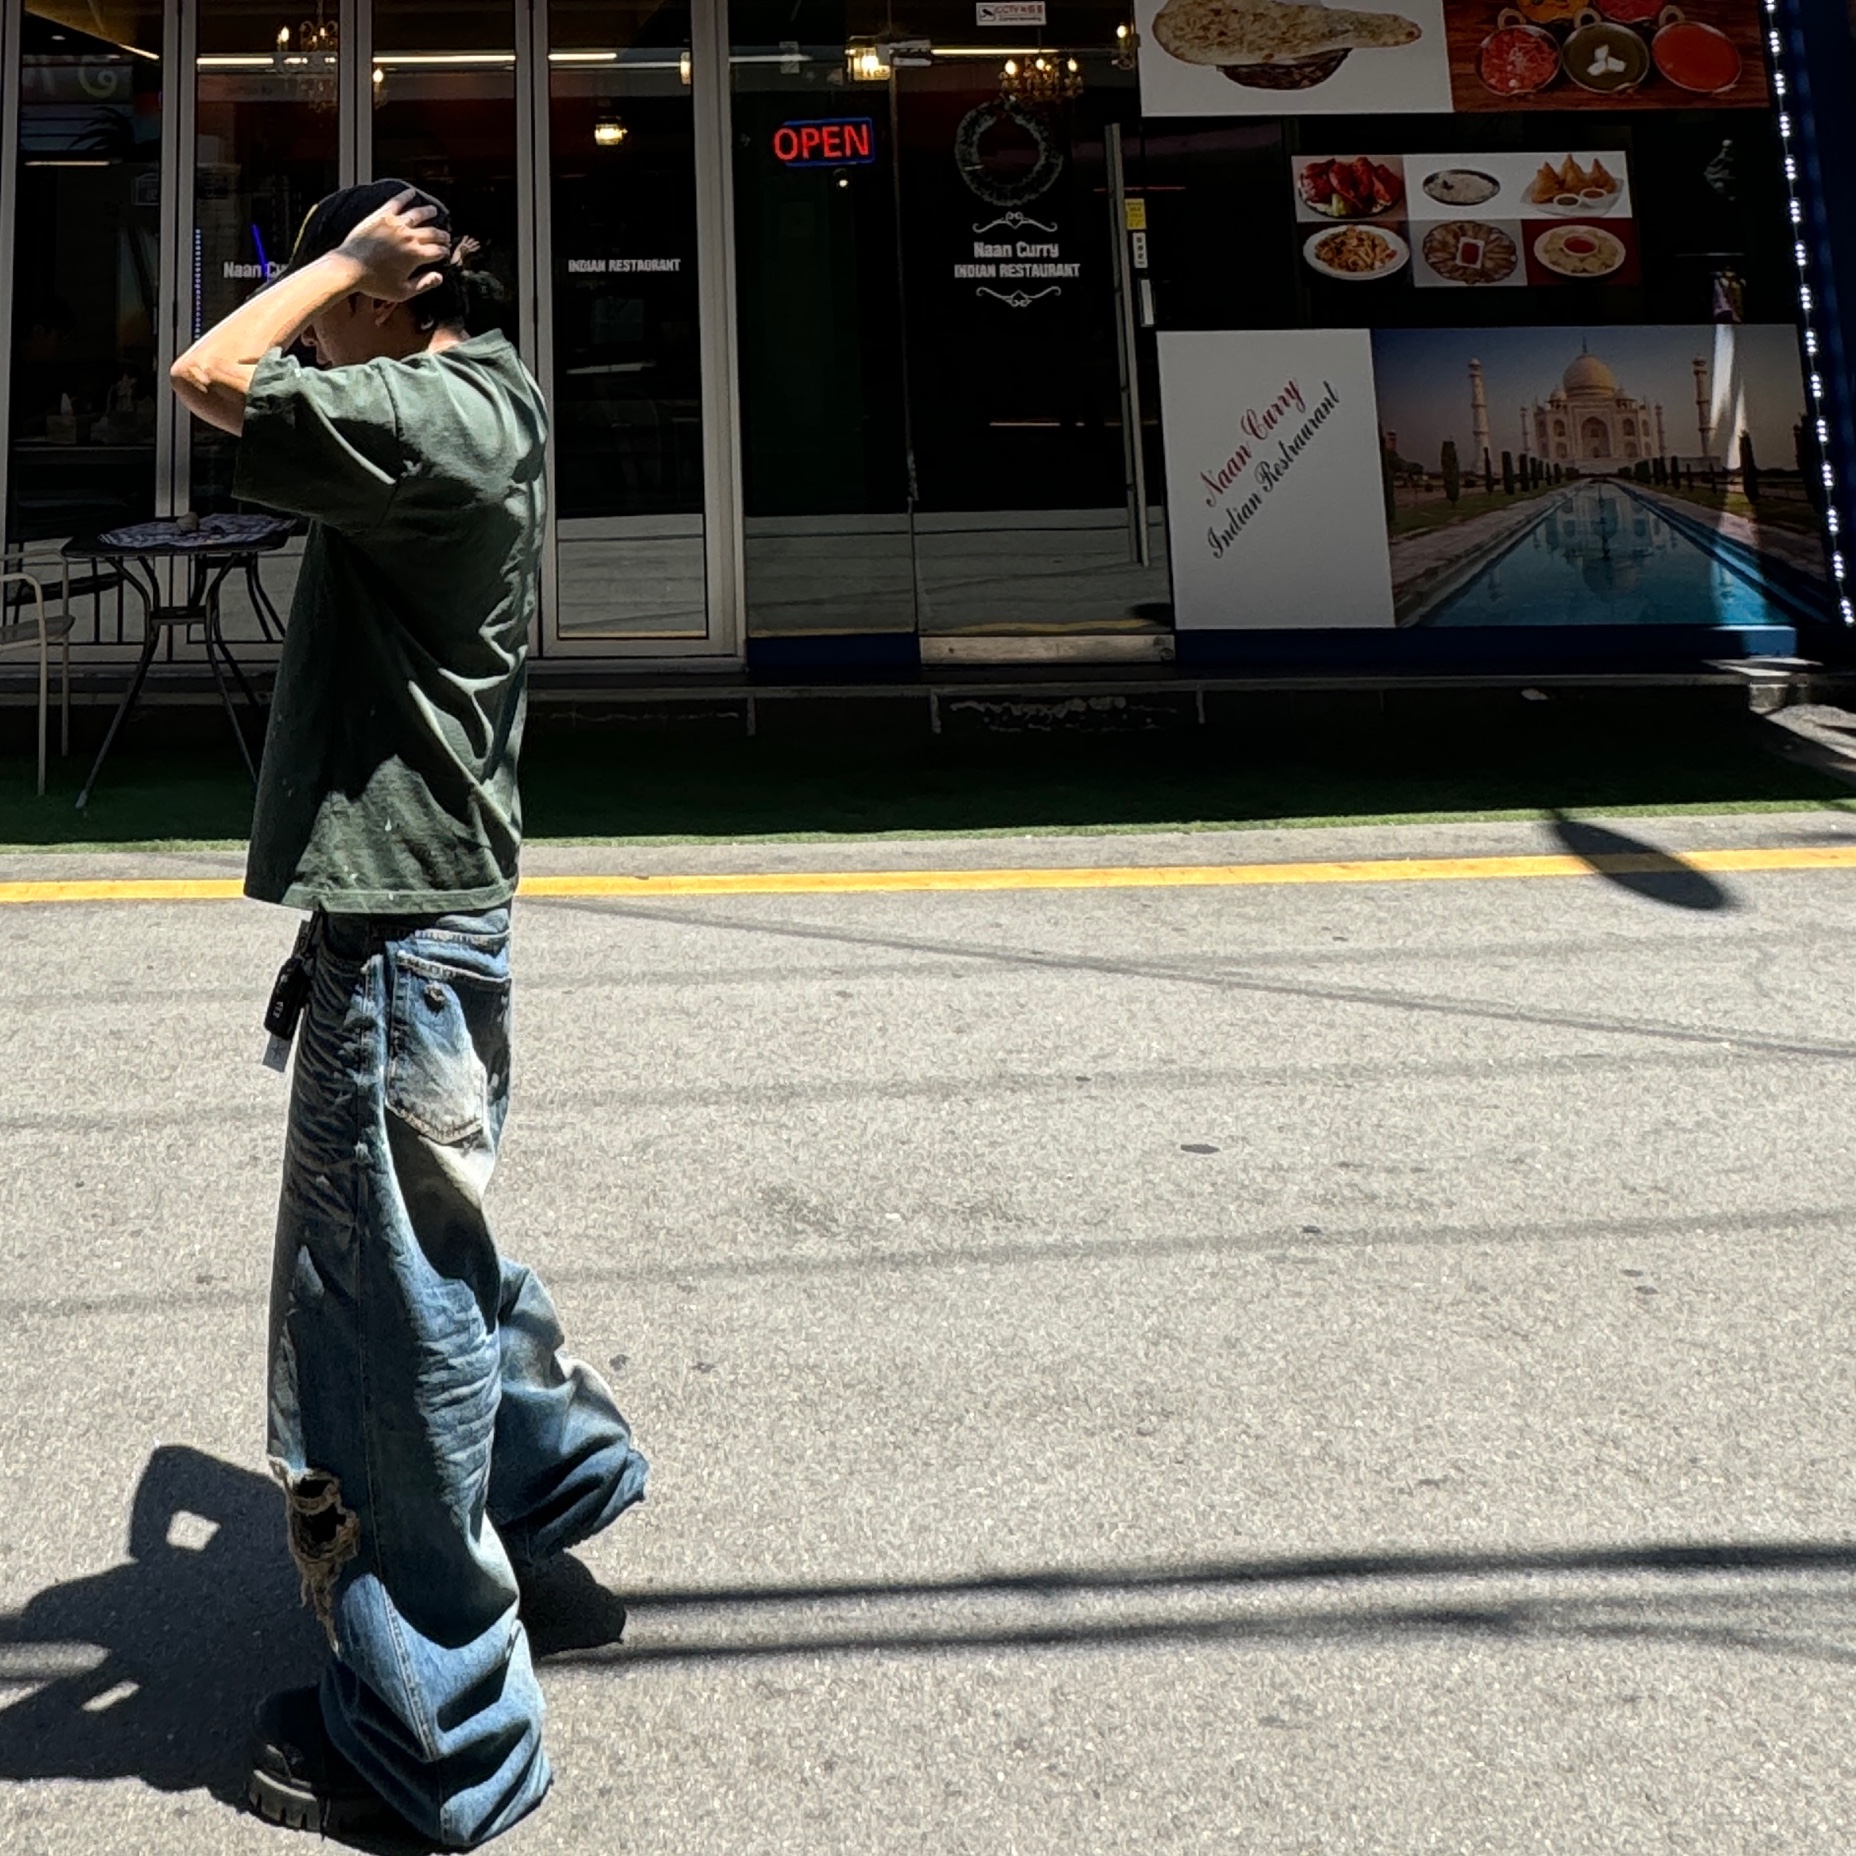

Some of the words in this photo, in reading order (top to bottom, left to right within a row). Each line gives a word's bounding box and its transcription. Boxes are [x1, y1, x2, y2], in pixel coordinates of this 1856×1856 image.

[774, 124, 869, 160] OPEN
[974, 241, 1012, 258] Naan
[1016, 241, 1059, 258] Curry
[223, 261, 262, 278] Naan
[568, 259, 606, 272] INDIAN
[608, 259, 681, 272] RESTAURANT
[954, 264, 996, 278] INDIAN
[1000, 263, 1080, 278] RESTAURANT
[1199, 443, 1253, 508] Naan
[1241, 377, 1306, 441] Curry
[1207, 491, 1262, 559] Indian
